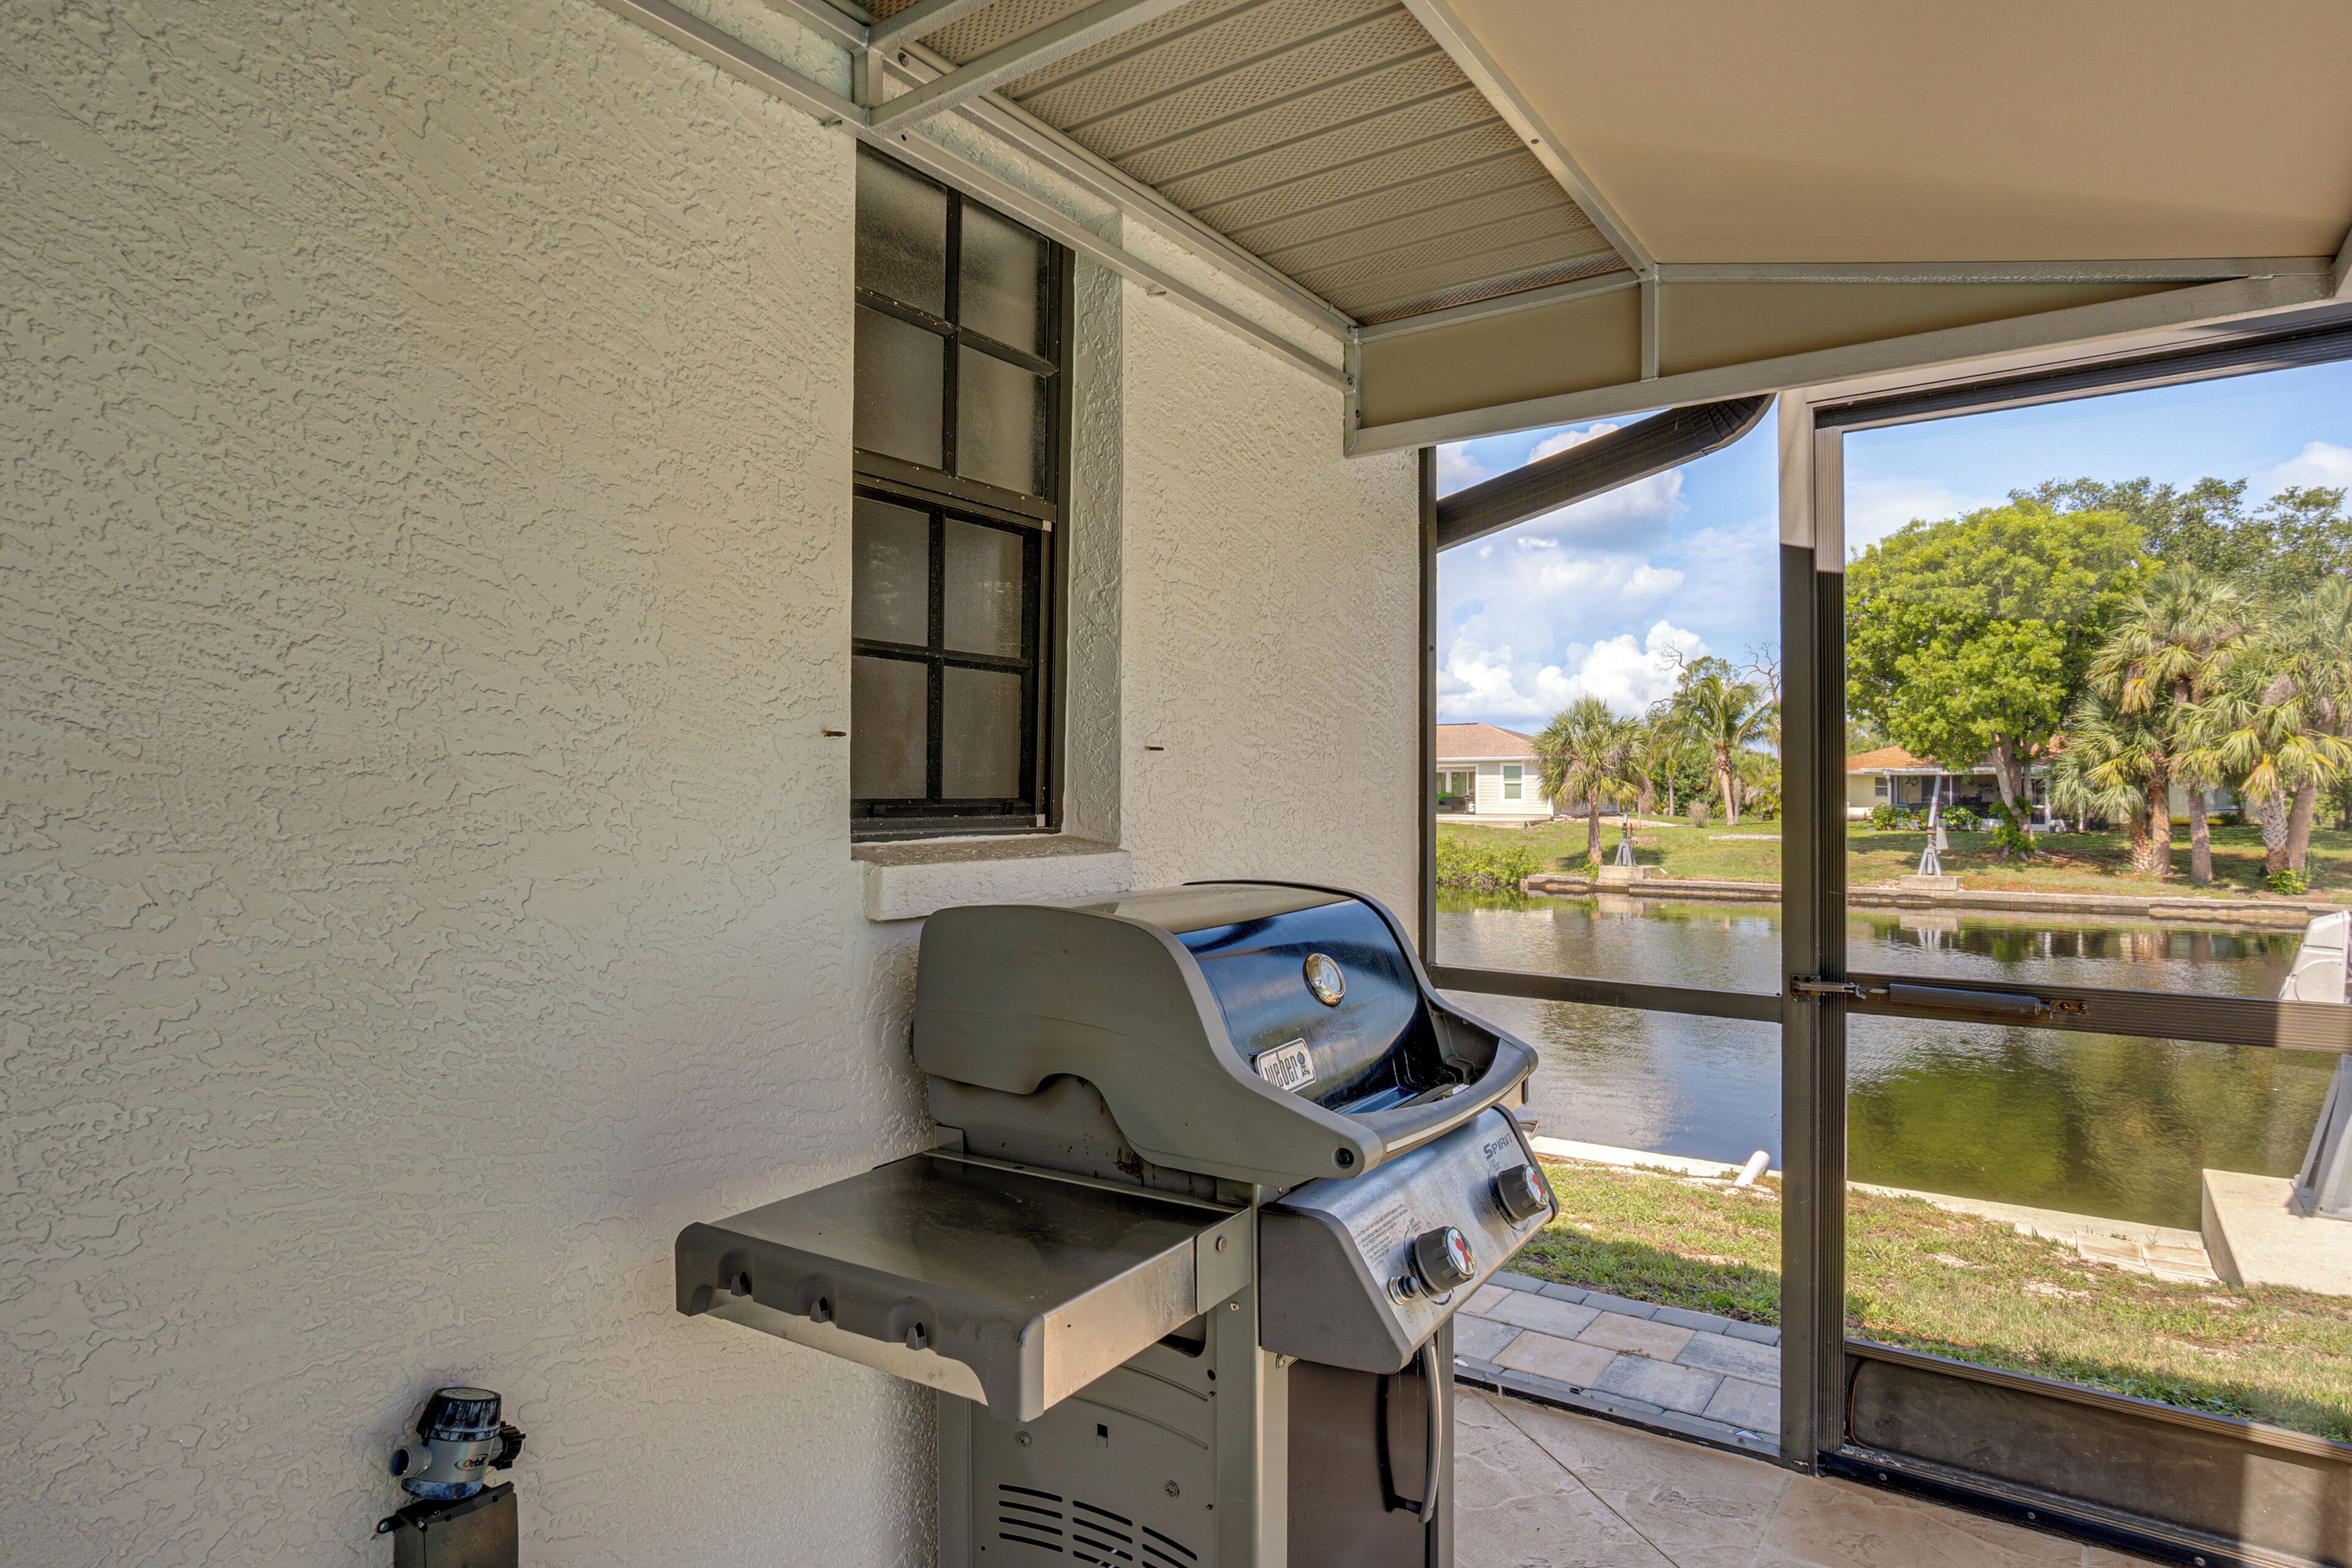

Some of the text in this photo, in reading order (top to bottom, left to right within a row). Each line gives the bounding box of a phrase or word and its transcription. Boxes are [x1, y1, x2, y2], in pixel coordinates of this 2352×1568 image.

[1264, 1051, 1298, 1088] weber
[1483, 1133, 1512, 1160] SPIRIT
[462, 1455, 488, 1468] Orbit
